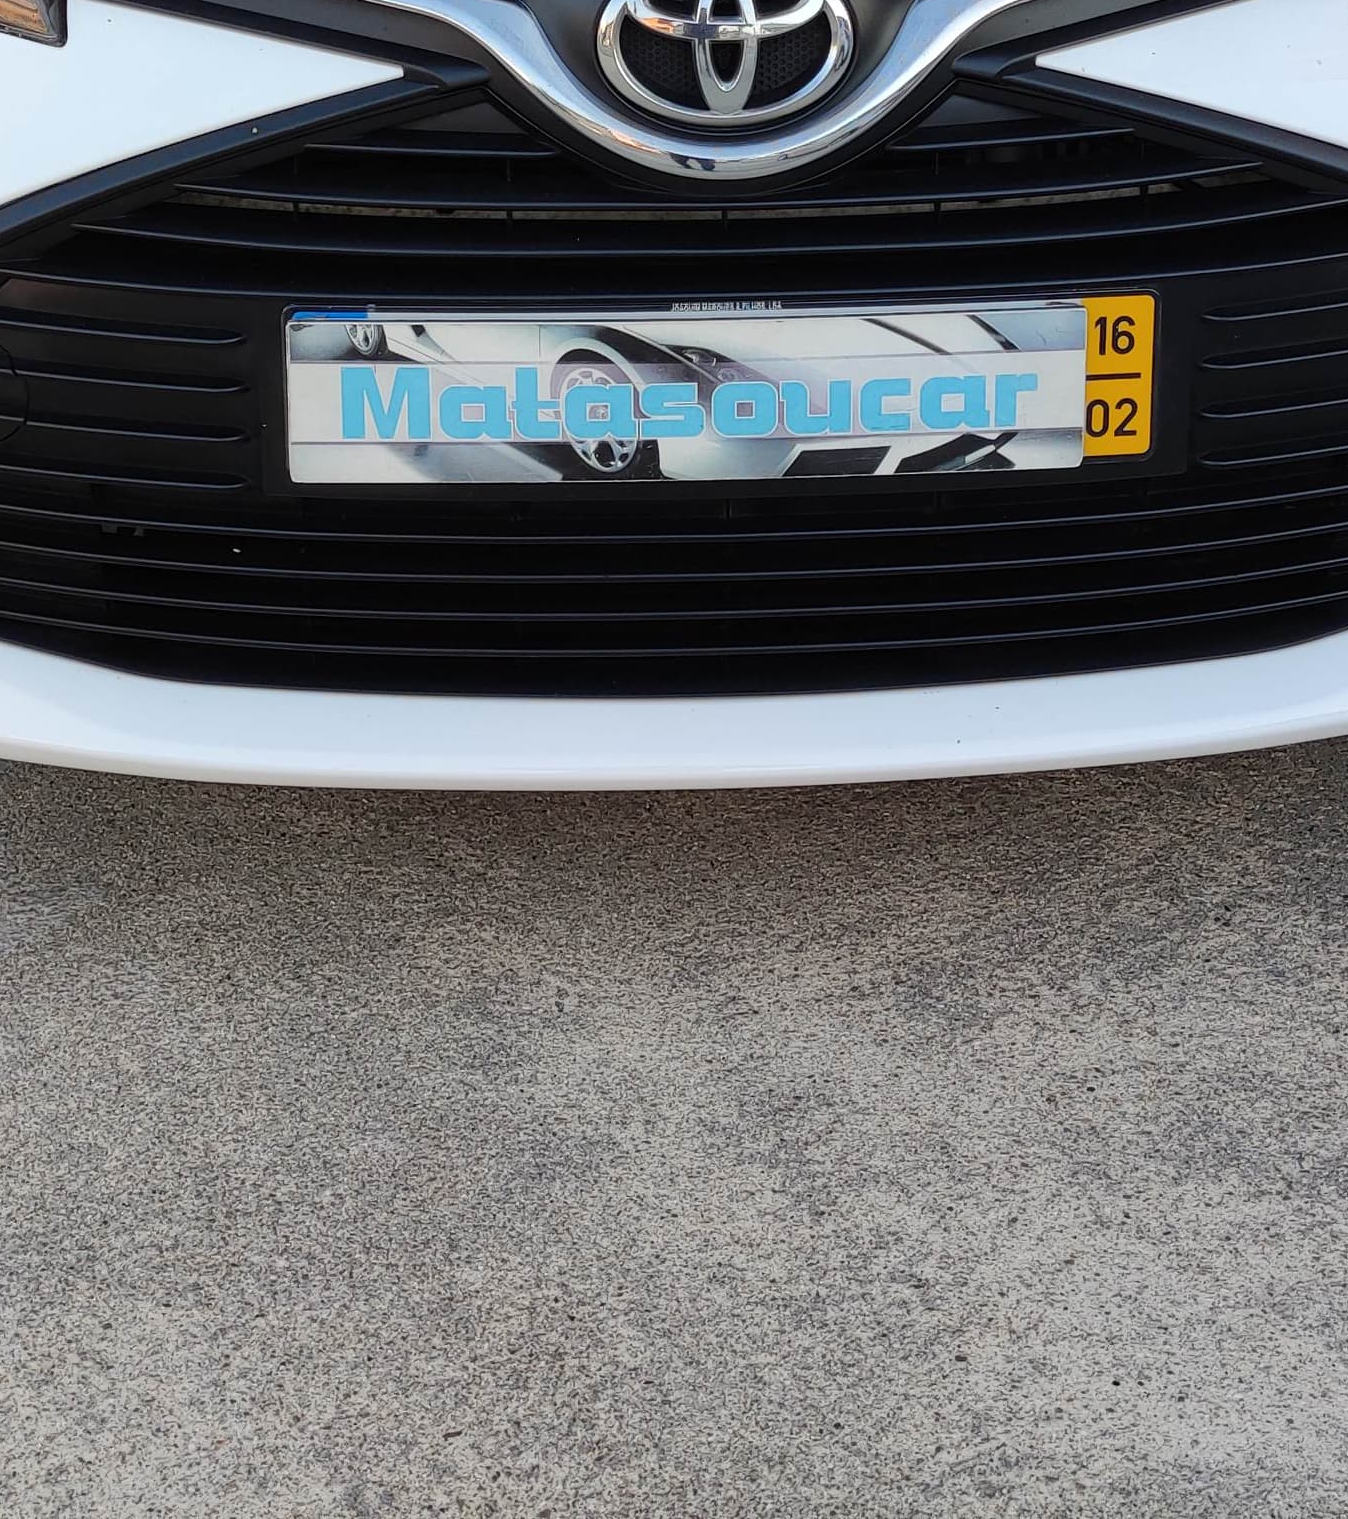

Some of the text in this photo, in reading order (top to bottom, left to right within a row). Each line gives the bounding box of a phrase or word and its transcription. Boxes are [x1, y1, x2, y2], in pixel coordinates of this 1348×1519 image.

[1094, 314, 1136, 357] 16
[339, 365, 1039, 441] Matasoucar
[1085, 396, 1139, 438] 02
